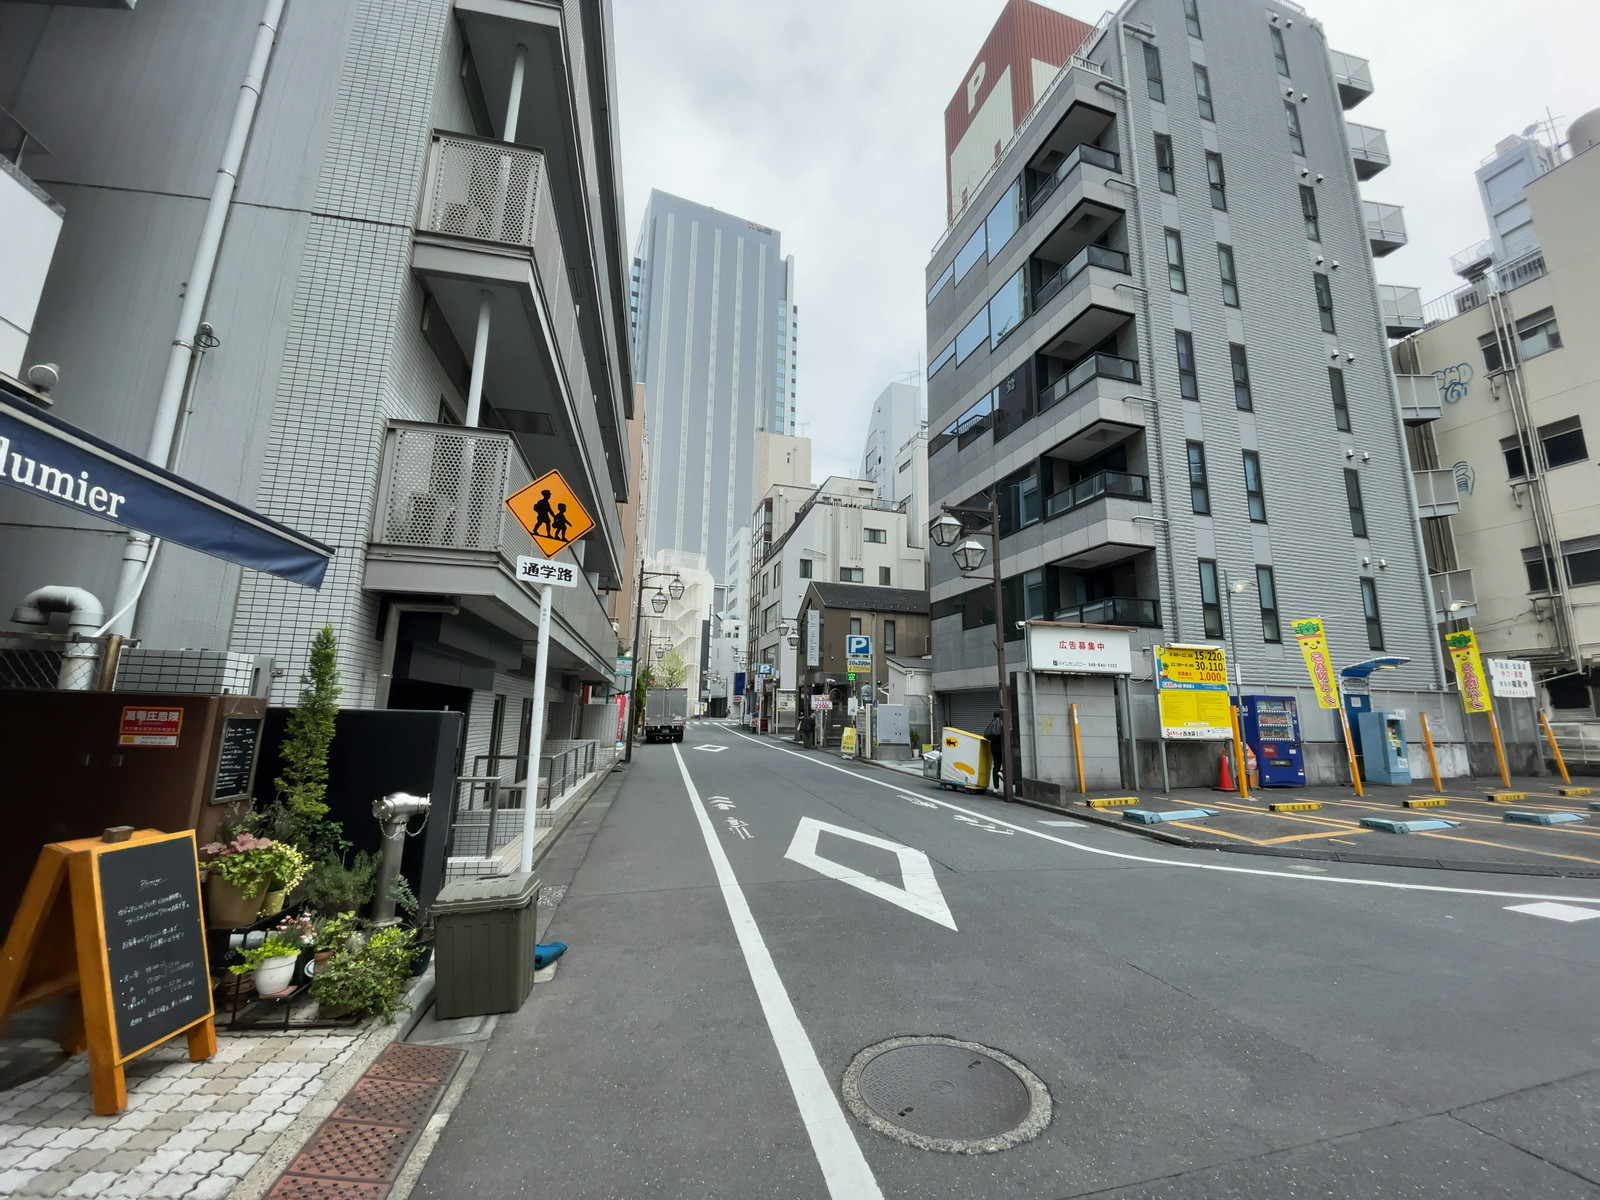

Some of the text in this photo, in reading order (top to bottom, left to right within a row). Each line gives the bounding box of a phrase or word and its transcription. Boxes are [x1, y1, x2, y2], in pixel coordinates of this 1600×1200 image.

[522, 562, 573, 582] 通学路
[850, 638, 867, 653] P
[1059, 640, 1105, 652] 広告募集中
